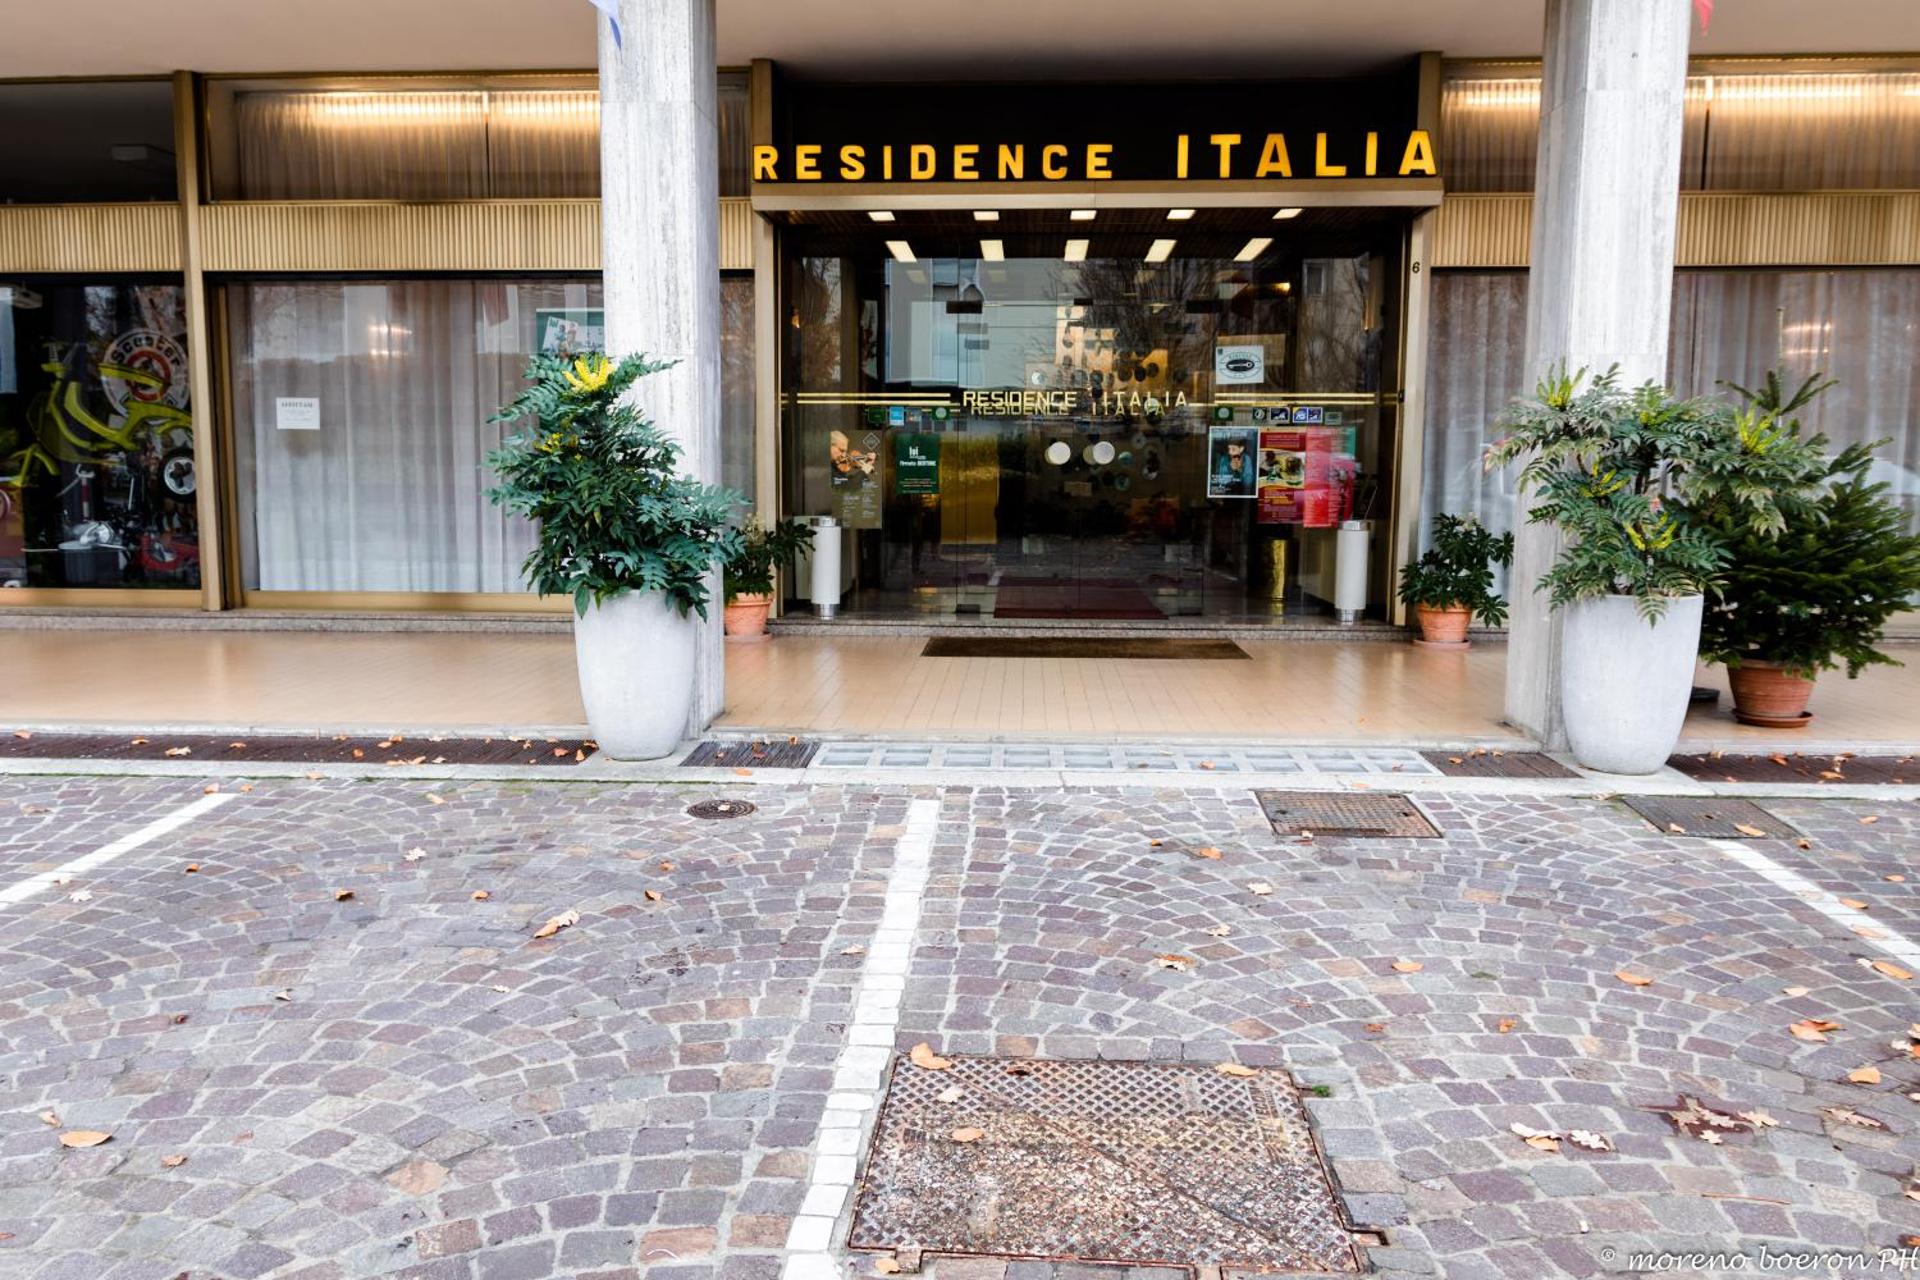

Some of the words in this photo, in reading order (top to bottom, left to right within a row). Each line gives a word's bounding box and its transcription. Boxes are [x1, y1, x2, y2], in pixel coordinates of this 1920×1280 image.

[752, 144, 1113, 180] RESIDENCE
[1177, 130, 1437, 178] ITALIA
[1412, 261, 1421, 274] 6
[963, 391, 1078, 407] RESIDENCE
[1103, 390, 1187, 407] ITALIA
